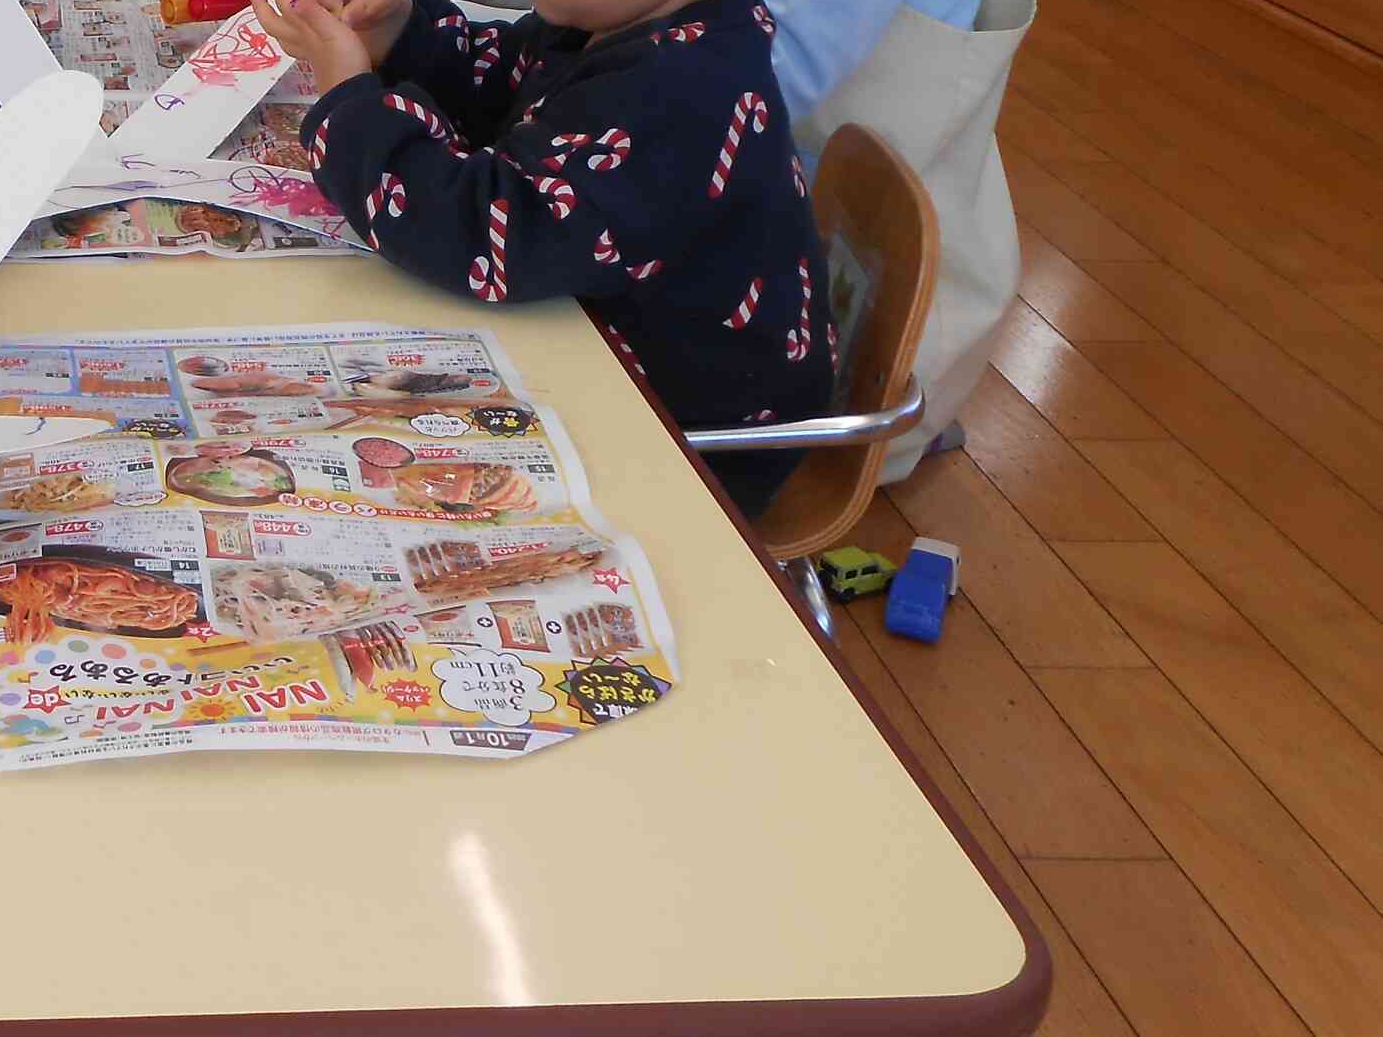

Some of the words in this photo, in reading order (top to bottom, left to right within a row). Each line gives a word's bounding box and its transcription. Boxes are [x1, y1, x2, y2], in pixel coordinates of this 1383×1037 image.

[30, 692, 59, 707] de
[181, 676, 261, 702] NAI
[243, 680, 327, 713] NAI
[96, 699, 175, 720] NAI
